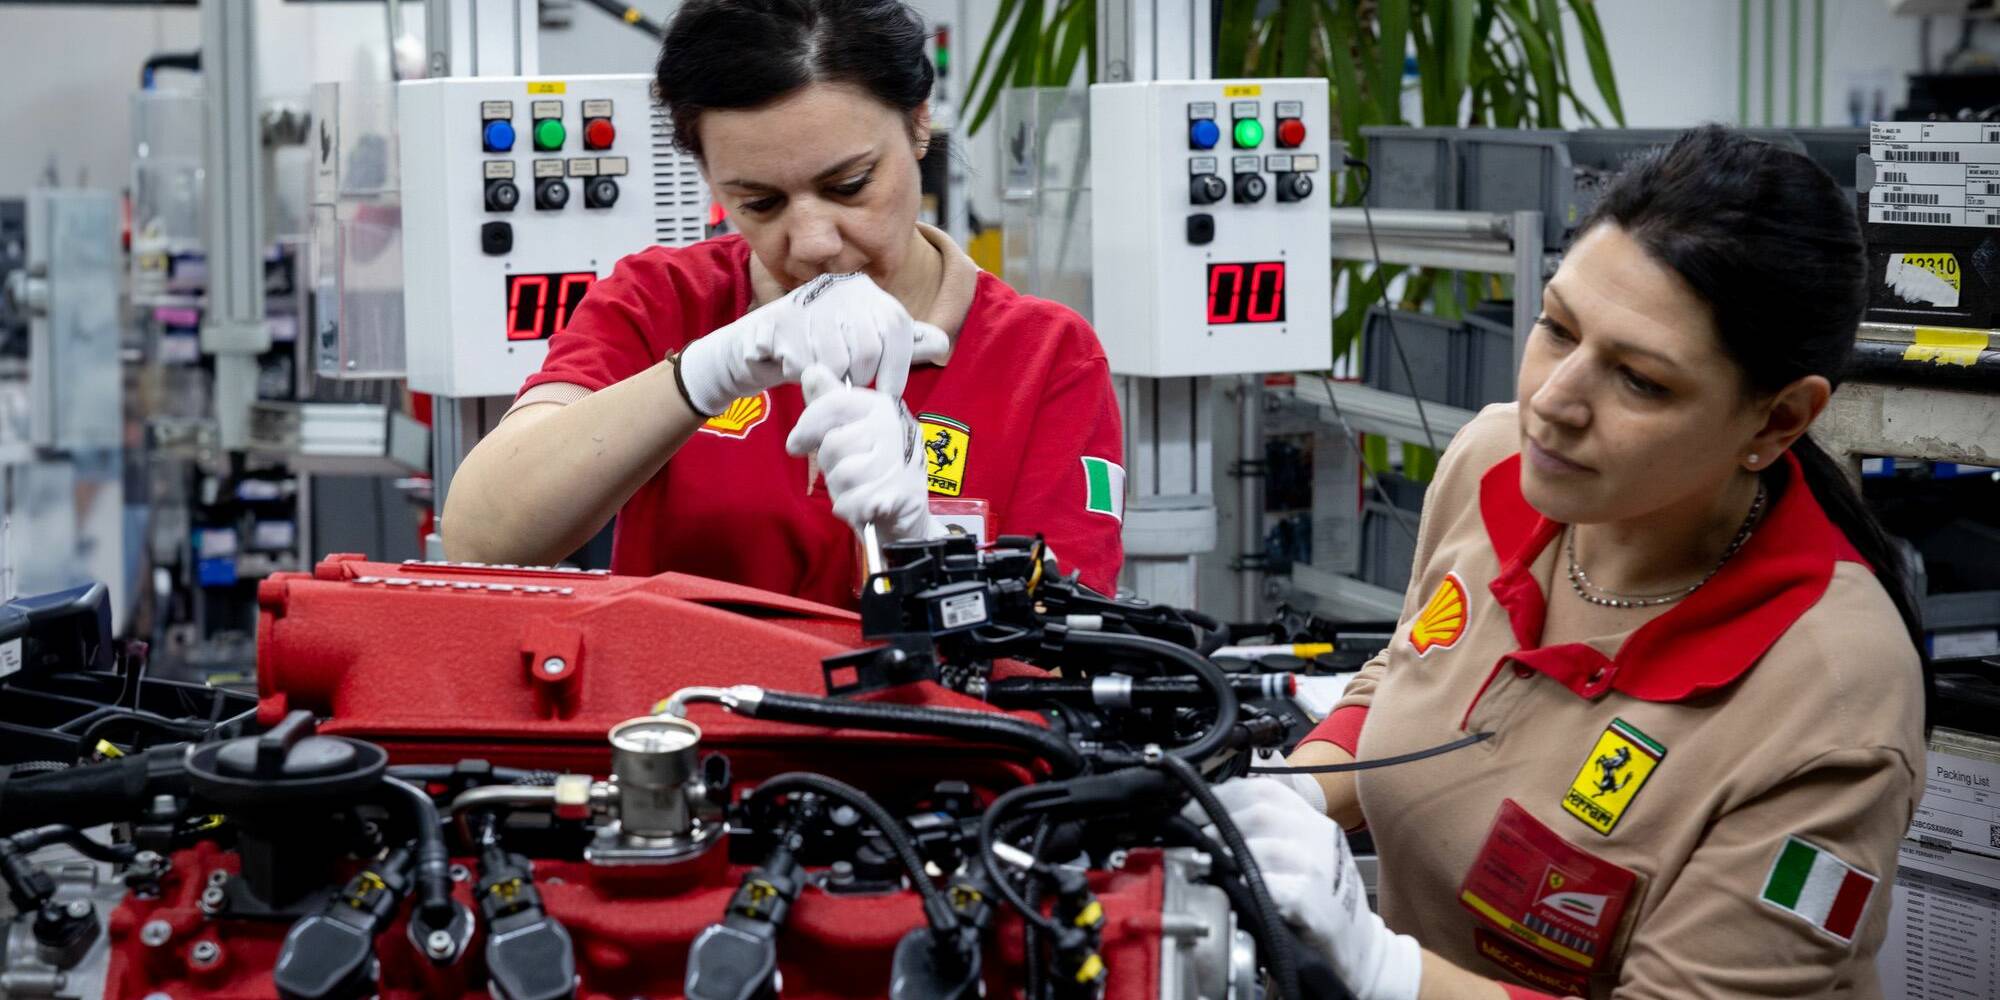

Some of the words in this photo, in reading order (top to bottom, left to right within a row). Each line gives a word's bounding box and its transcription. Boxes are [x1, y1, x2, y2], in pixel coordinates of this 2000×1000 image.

[1207, 263, 1284, 323] 00
[1936, 766, 1972, 786] Packing
[1973, 774, 1990, 787] List
[1568, 788, 1614, 826] Ferrari
